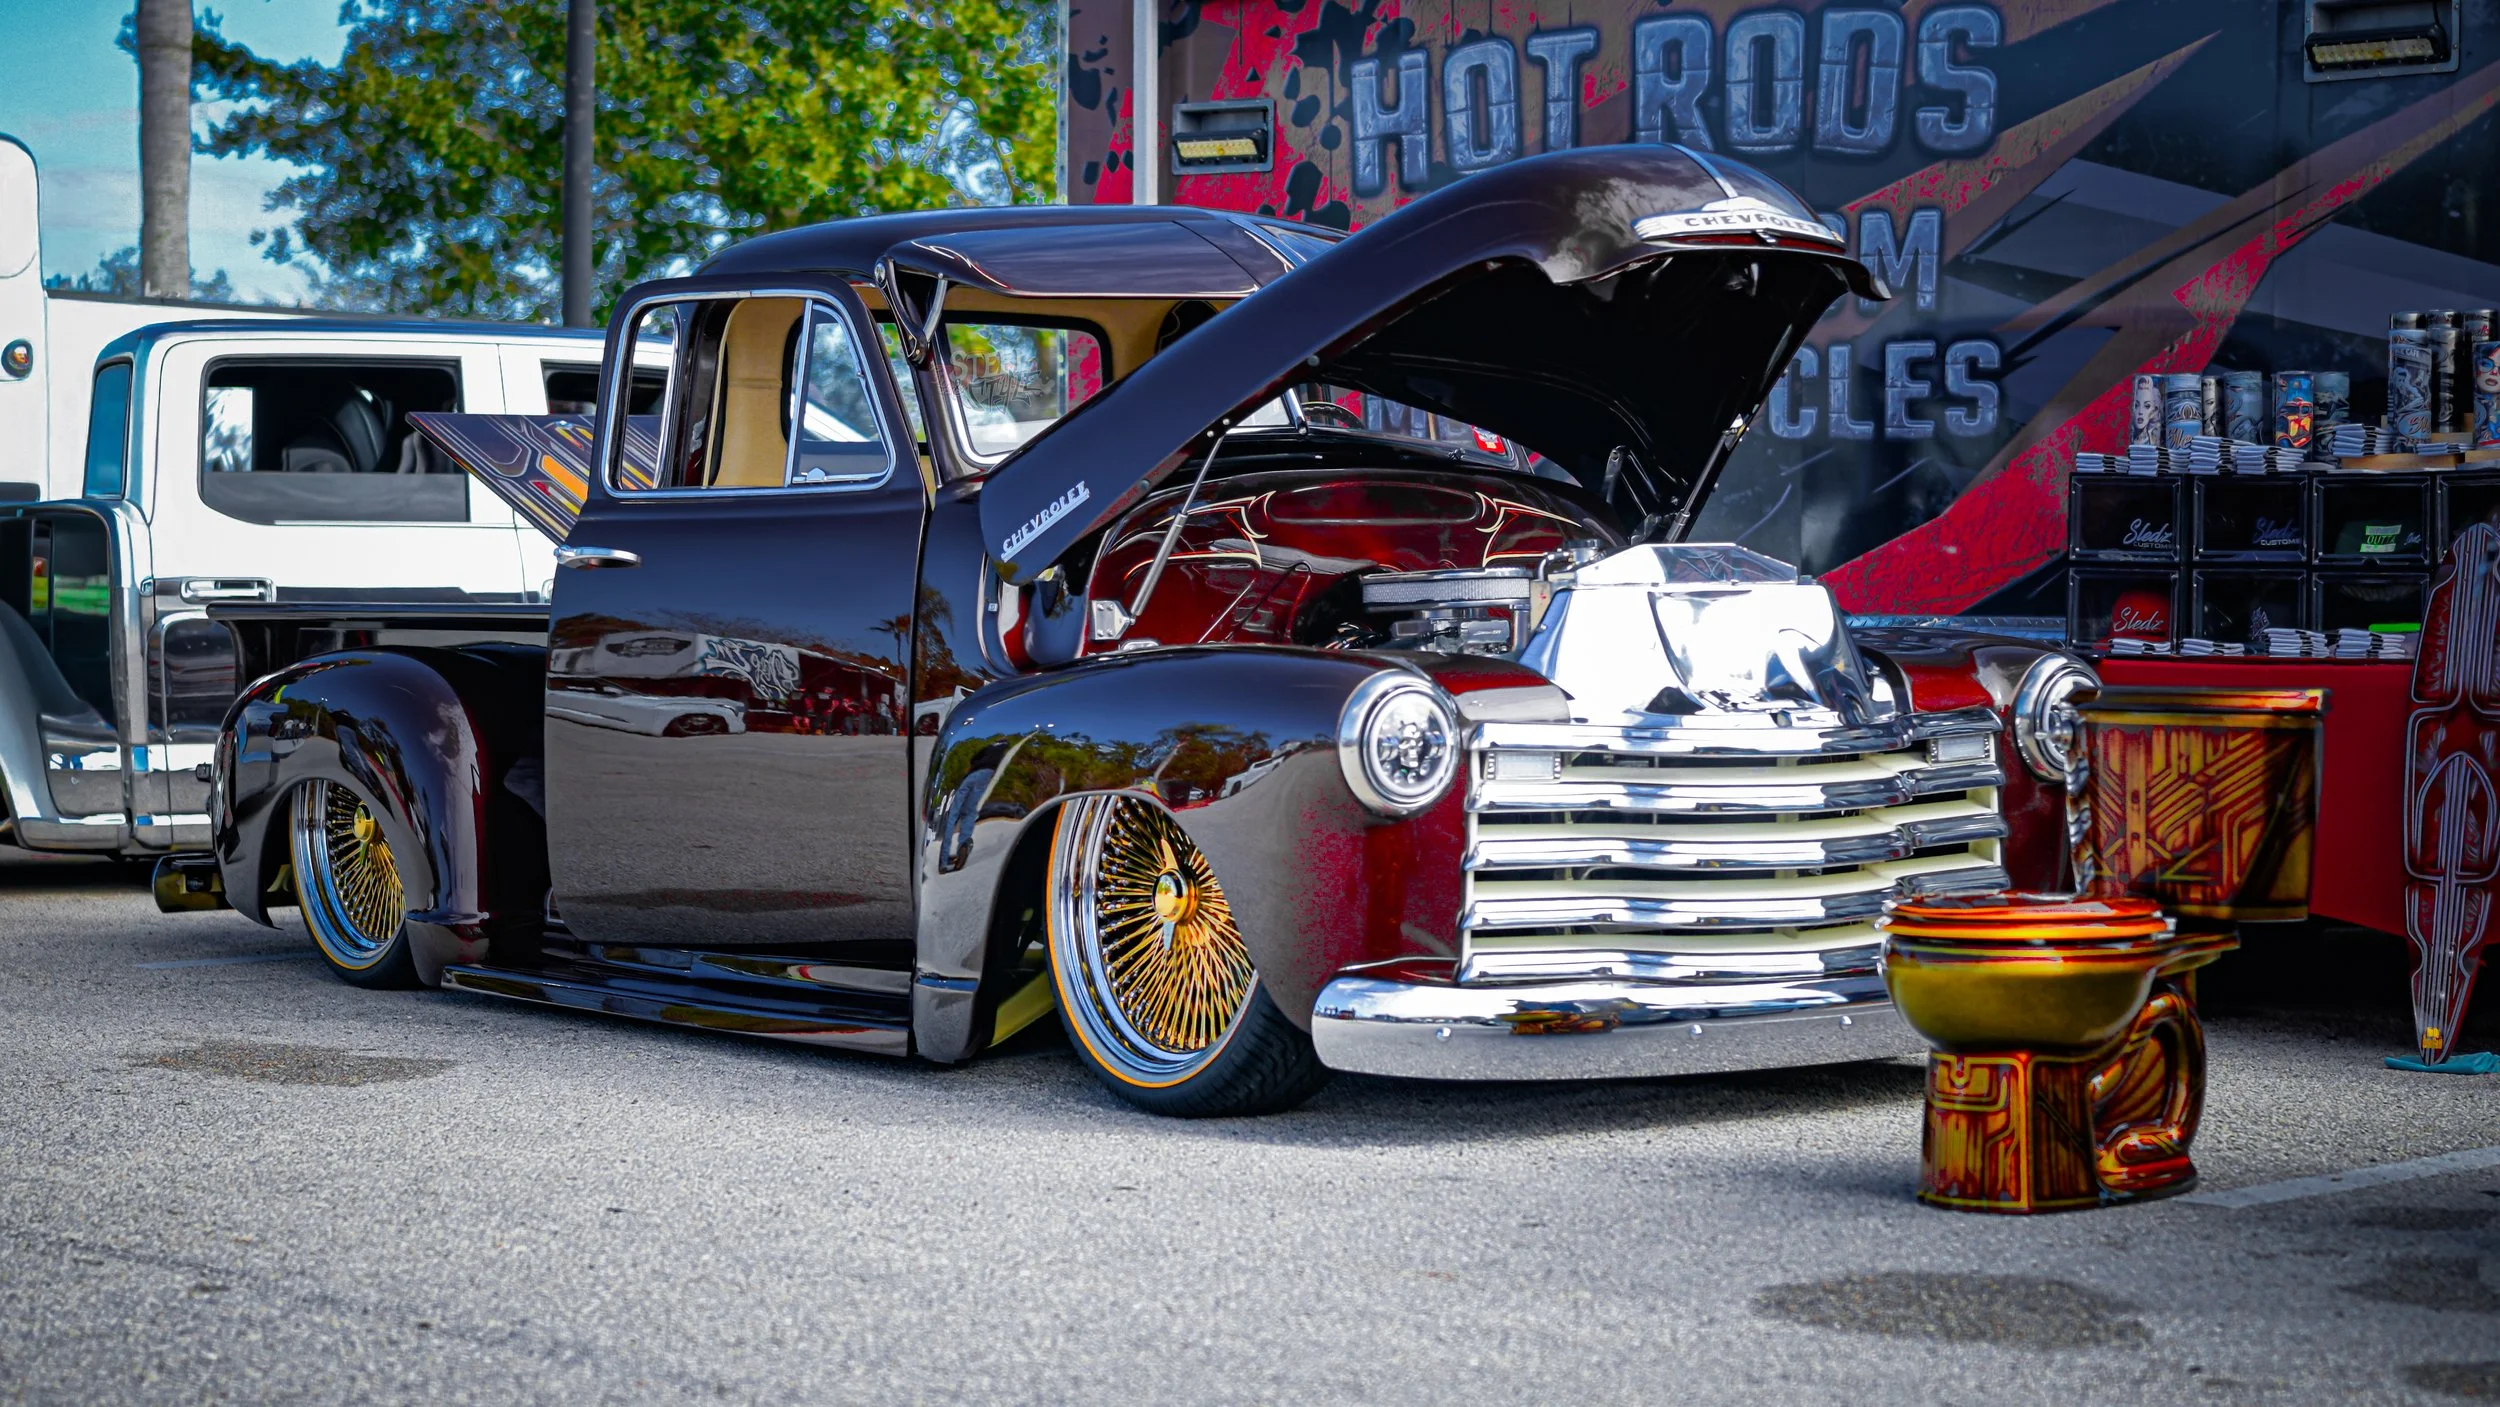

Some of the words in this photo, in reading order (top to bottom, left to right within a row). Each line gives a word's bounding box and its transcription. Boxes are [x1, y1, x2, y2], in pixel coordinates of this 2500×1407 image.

[1350, 28, 1599, 196] HOT
[1633, 7, 2000, 156] RODS
[1683, 212, 1824, 234] CHEVROLET
[1001, 480, 1089, 558] CHEVROLET
[2122, 518, 2173, 546] Sledz
[2113, 605, 2165, 632] Sledz
